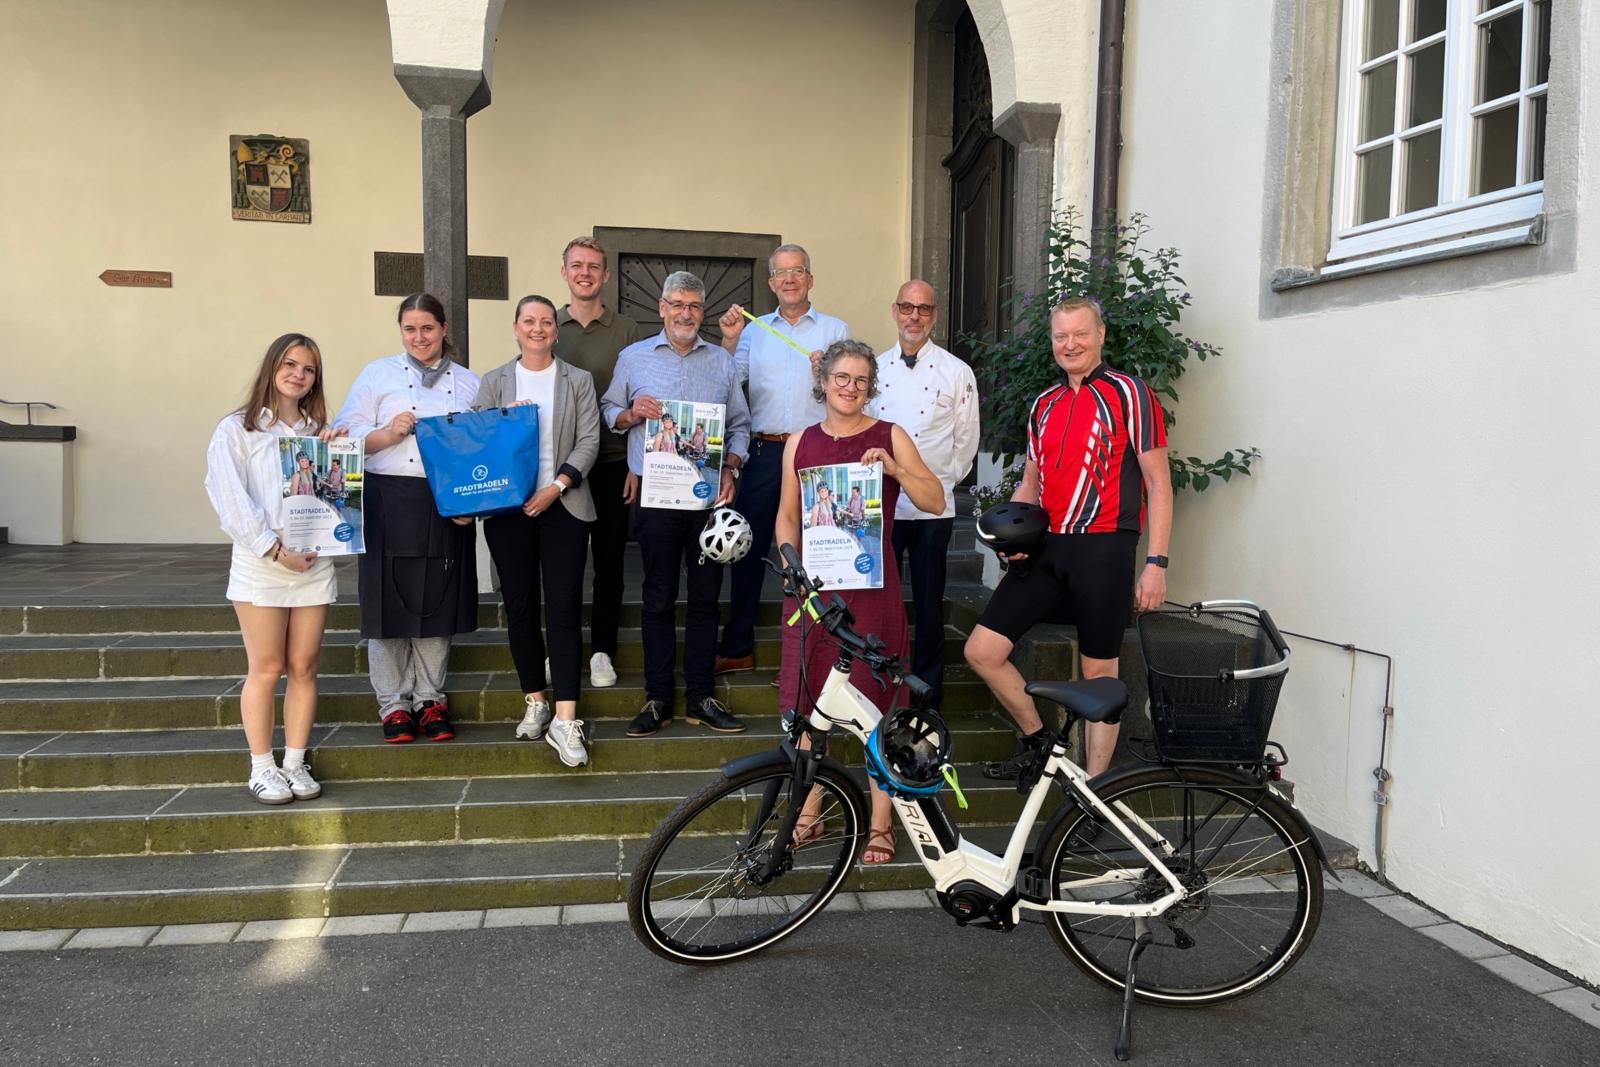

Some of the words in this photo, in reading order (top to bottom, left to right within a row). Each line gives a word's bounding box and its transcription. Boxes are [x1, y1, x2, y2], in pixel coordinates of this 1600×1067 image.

[650, 463, 692, 472] STADTRADELN
[453, 478, 509, 494] STADTRADELN
[808, 538, 852, 546] STADTRADELN
